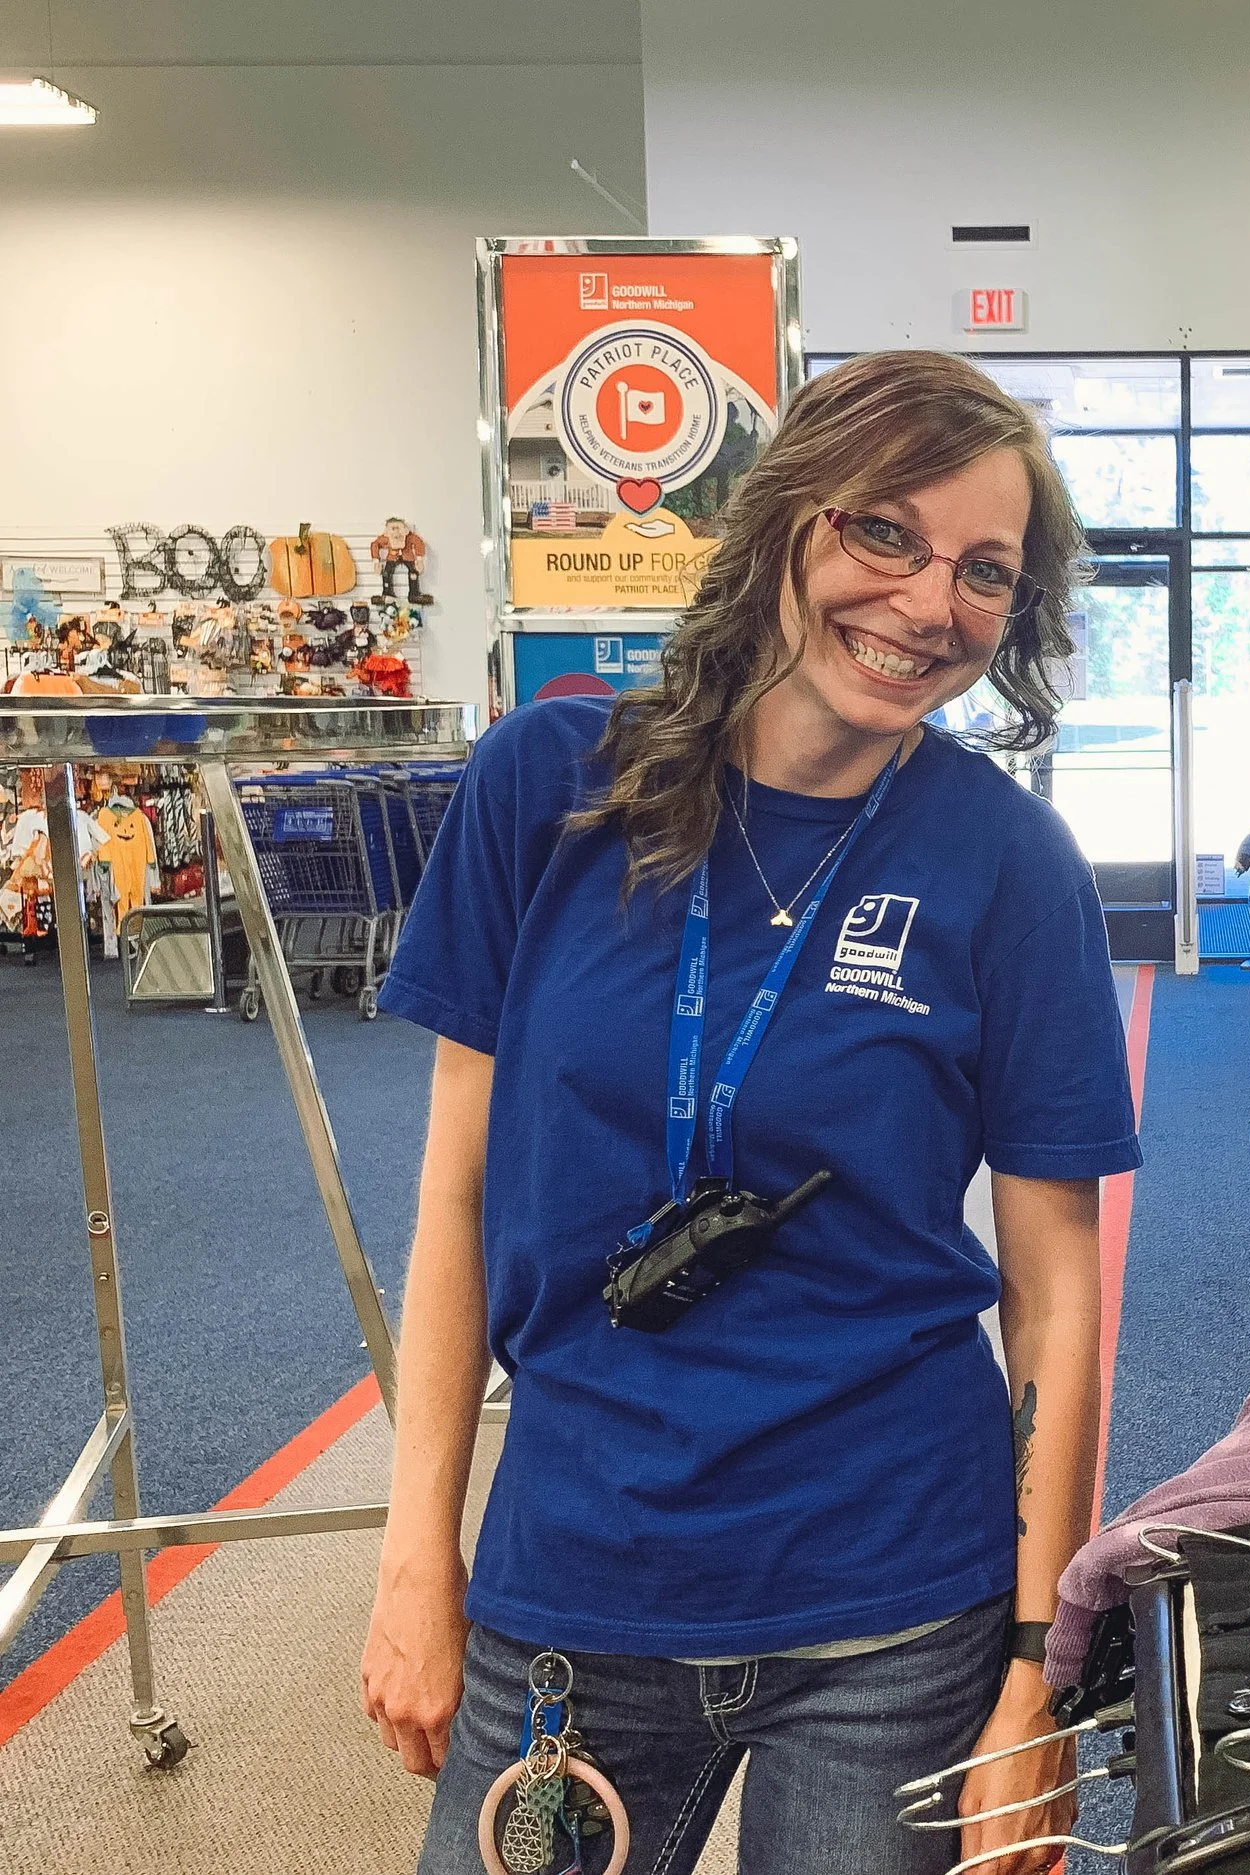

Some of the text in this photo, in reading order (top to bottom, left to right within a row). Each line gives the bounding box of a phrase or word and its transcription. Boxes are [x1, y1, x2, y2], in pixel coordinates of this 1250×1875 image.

[612, 285, 667, 297] GOODWILL
[612, 299, 695, 311] Northern Michigan
[972, 289, 1015, 324] EXIT
[580, 343, 699, 390] PATRIOT PLACE
[579, 414, 701, 472] HELPING VETERANS TRANSITION HOME
[546, 553, 612, 571] ROUND
[619, 553, 643, 571] UP
[651, 553, 687, 571] FOR
[615, 585, 679, 593] PATRIOT PLACE
[629, 575, 672, 584] community
[840, 946, 898, 962] goodwill
[688, 957, 698, 994] GOODWILL
[830, 966, 904, 991] GOODWILL
[824, 982, 931, 1016] Northern Michigan
[679, 1057, 689, 1096] GOODWILL
